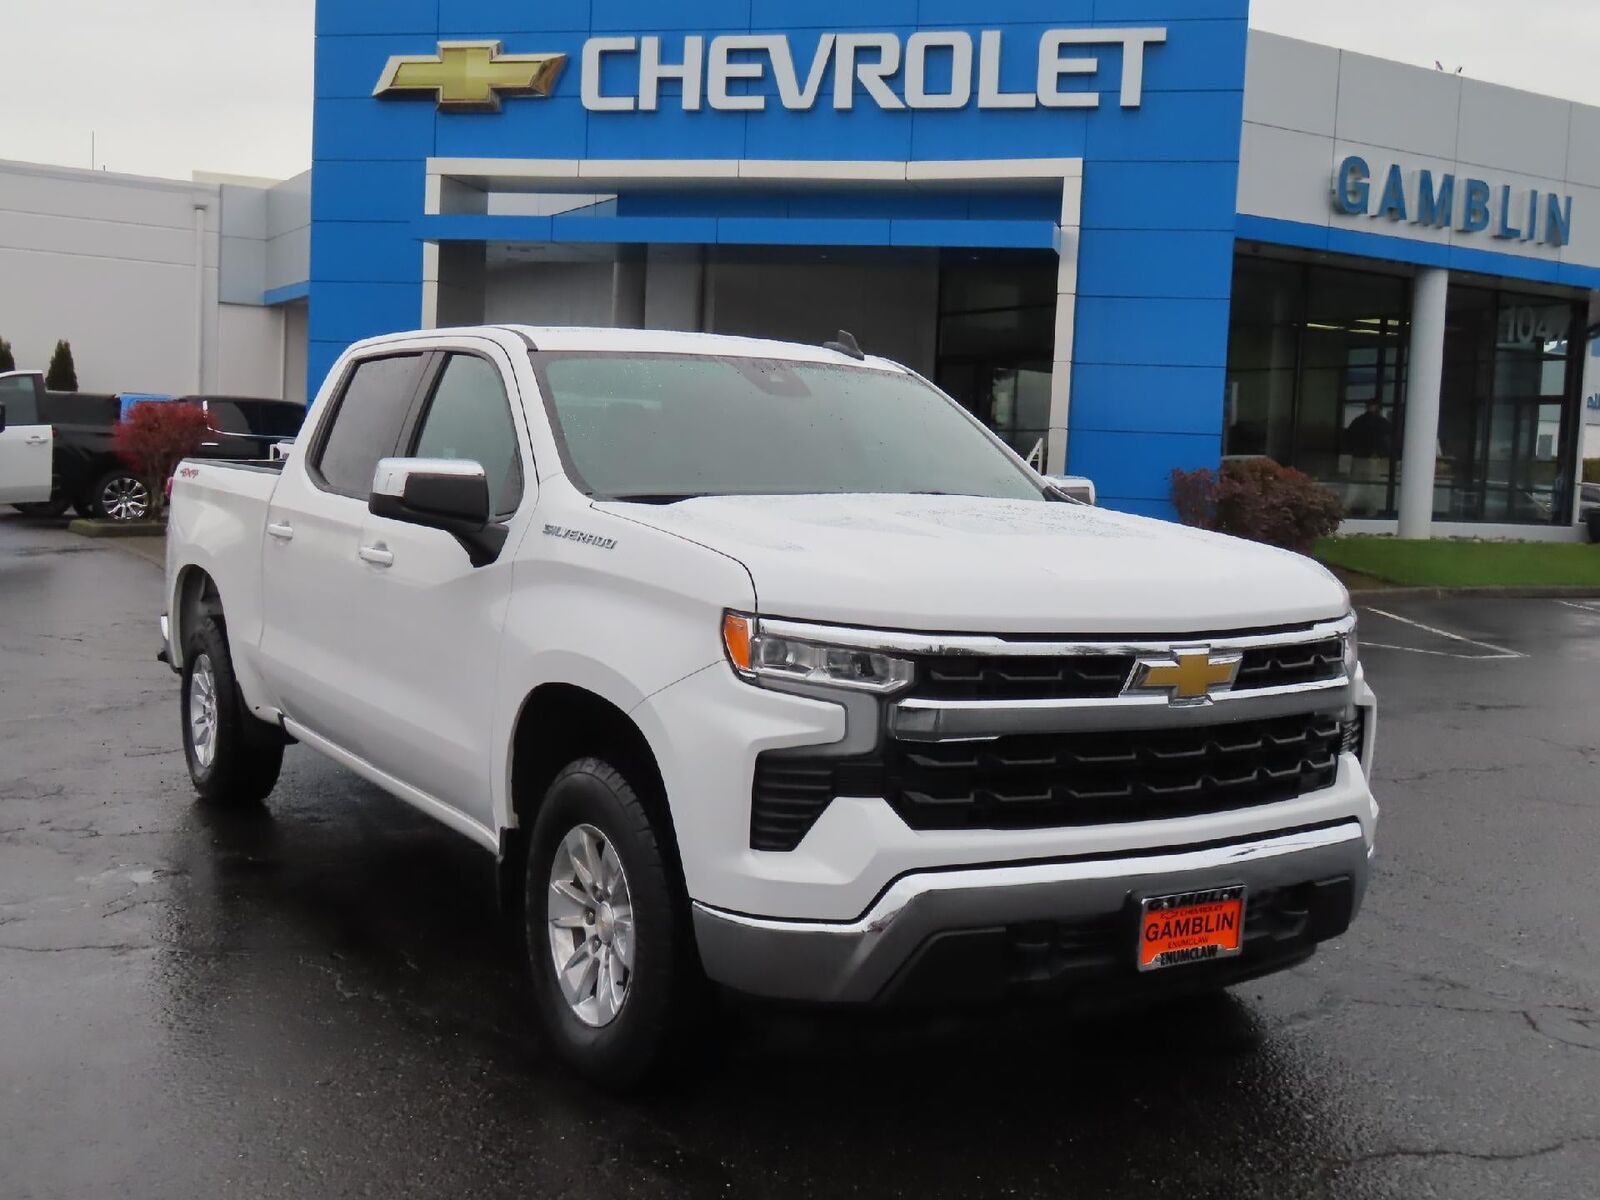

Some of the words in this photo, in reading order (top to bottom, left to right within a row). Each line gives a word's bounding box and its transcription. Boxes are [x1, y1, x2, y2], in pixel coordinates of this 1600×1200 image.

[580, 27, 1168, 112] CHEVROLET
[1332, 155, 1572, 246] GAMBLIN
[542, 524, 618, 549] SILVERADO
[1145, 912, 1234, 942] GAMBLIN
[1167, 937, 1209, 949] ENUMCLAW
